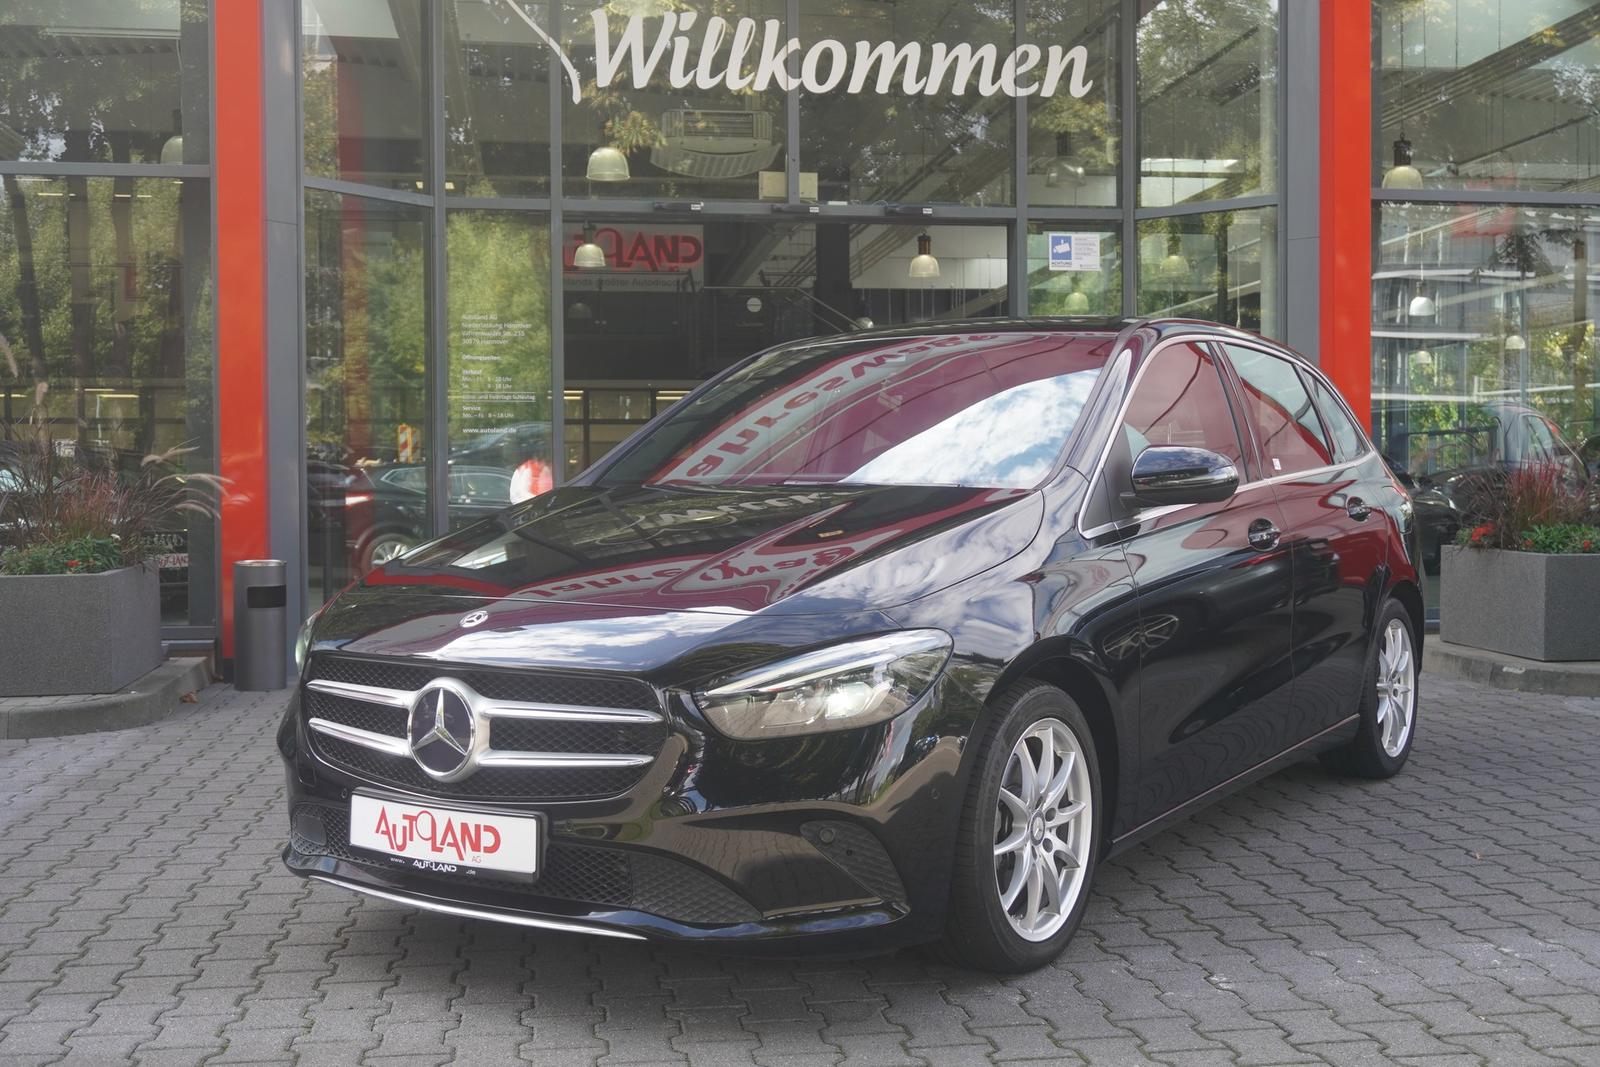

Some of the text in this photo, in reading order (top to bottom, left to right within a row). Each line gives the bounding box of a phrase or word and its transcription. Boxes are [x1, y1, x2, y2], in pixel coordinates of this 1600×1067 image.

[591, 8, 1094, 98] Willkommen
[375, 805, 501, 861] AUTOLAND
[412, 859, 457, 873] AUTOLAND
[472, 856, 482, 864] AG
